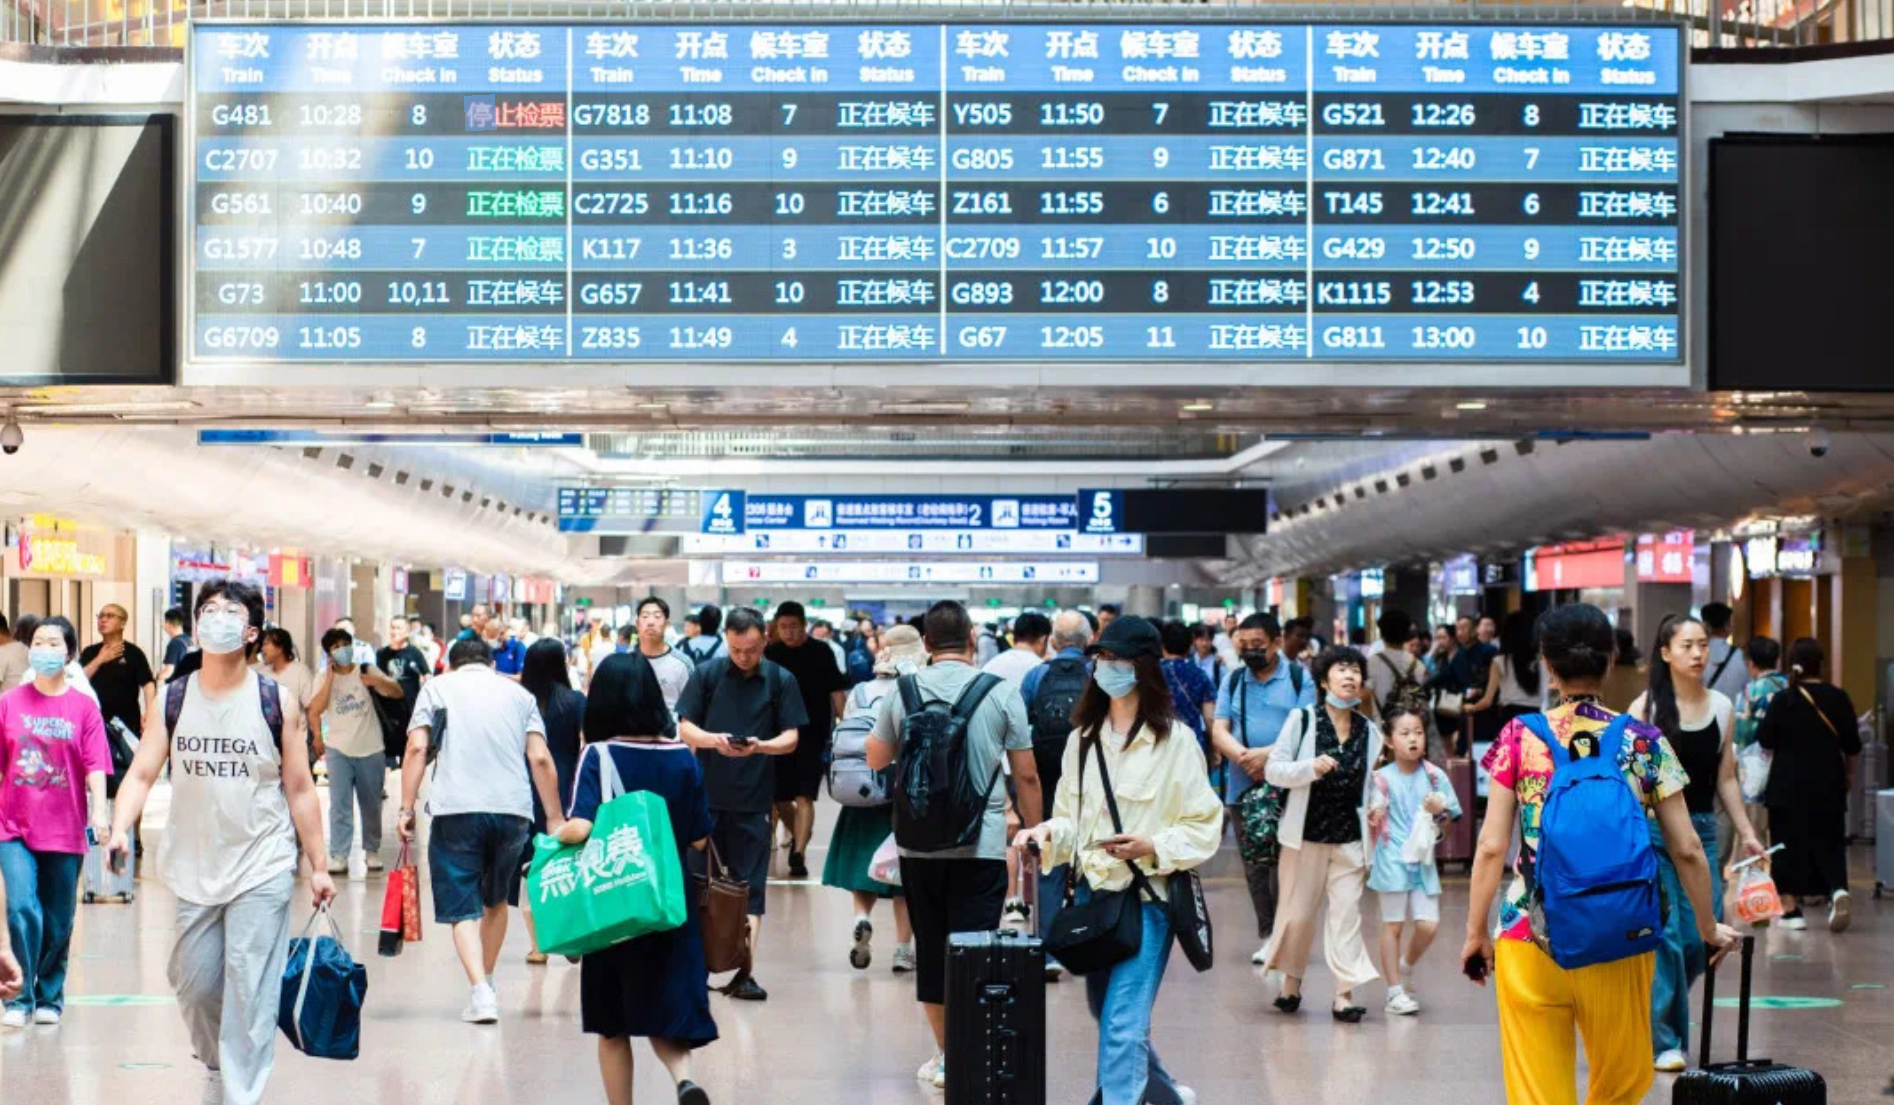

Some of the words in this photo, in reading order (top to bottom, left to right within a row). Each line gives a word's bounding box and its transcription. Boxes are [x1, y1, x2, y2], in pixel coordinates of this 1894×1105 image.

[219, 34, 269, 59] 车次
[307, 33, 359, 59] 开点
[382, 33, 458, 59] 候车室
[489, 33, 541, 59] 状态
[587, 32, 638, 59] 车次
[676, 32, 728, 59] 开点
[751, 32, 829, 59] 候车室
[858, 32, 911, 59] 状态
[957, 32, 1008, 59] 车次
[1046, 32, 1098, 59] 开点
[1121, 32, 1199, 59] 候车室
[1229, 32, 1282, 59] 状态
[1327, 32, 1379, 59] 车次
[1416, 32, 1469, 59] 开点
[1491, 32, 1568, 59] 候车室
[1598, 32, 1649, 59] 状态
[222, 68, 263, 83] Train
[382, 68, 434, 83] Check
[488, 68, 543, 83] Status
[591, 68, 633, 83] Train
[681, 68, 722, 83] Time
[751, 68, 804, 83] Check
[811, 68, 828, 83] in
[859, 68, 914, 83] Status
[962, 67, 1005, 82] Train
[1052, 67, 1094, 82] Time
[1122, 67, 1177, 82] Check
[1182, 67, 1199, 82] in
[1231, 67, 1286, 82] Status
[1333, 68, 1376, 83] Train
[1423, 68, 1465, 83] Time
[1494, 68, 1548, 83] Check
[1552, 68, 1569, 83] in
[1601, 68, 1656, 84] Status
[212, 104, 272, 127] G481
[300, 104, 361, 126] 10:28
[412, 104, 427, 126] 8
[467, 102, 564, 128] 停止检票
[574, 104, 650, 127] G7818
[670, 104, 732, 126] 11:08
[782, 104, 797, 126] 7
[838, 102, 935, 128] 正在候车
[954, 103, 1012, 126] Y505
[1041, 103, 1104, 125] 11:50
[1153, 103, 1168, 125] 7
[1209, 102, 1306, 127] 正在候车
[1323, 104, 1385, 127] G521
[1412, 104, 1476, 126] 12:26
[1524, 104, 1540, 126] 8
[1579, 103, 1676, 128] 正在候车
[206, 149, 278, 171] C2707
[300, 149, 361, 171] 10:32
[406, 149, 433, 171] 10
[467, 146, 564, 172] 正在检票
[581, 149, 642, 171] G351
[670, 149, 732, 171] 11:10
[782, 149, 797, 171] 9
[838, 146, 935, 172] 正在候车
[952, 148, 1013, 171] G805
[1041, 148, 1103, 170] 11:55
[1153, 148, 1169, 170] 9
[1209, 146, 1306, 172] 正在候车
[1323, 149, 1385, 171] G871
[1412, 149, 1475, 171] 12:40
[1524, 149, 1539, 171] 7
[1579, 147, 1676, 173] 正在候车
[212, 193, 271, 216] G561
[301, 193, 361, 215] 10:40
[412, 193, 426, 215] 9
[467, 191, 564, 217] 正在检票
[575, 193, 649, 216] C2725
[670, 193, 732, 215] 11:16
[776, 193, 804, 215] 10
[838, 191, 935, 217] 正在候车
[953, 192, 1012, 215] Z161
[1041, 192, 1103, 214] 11:55
[1153, 192, 1169, 214] 6
[1209, 191, 1306, 217] 正在候车
[1324, 193, 1383, 216] T145
[1412, 193, 1474, 215] 12:41
[1524, 193, 1540, 215] 6
[1579, 192, 1676, 218] 正在候车
[204, 238, 278, 261] G1577
[301, 238, 361, 260] 10:48
[412, 238, 426, 260] 7
[467, 236, 564, 262] 正在检票
[582, 238, 641, 261] K117
[670, 238, 732, 260] 11:36
[782, 238, 797, 260] 3
[838, 236, 935, 262] 正在候车
[946, 238, 1020, 260] C2709
[1041, 238, 1103, 259] 11:57
[1147, 238, 1176, 259] 10
[1209, 236, 1306, 262] 正在候车
[1323, 238, 1385, 261] G429
[1412, 238, 1475, 260] 12:50
[1524, 238, 1539, 260] 9
[1579, 237, 1676, 263] 正在候车
[219, 282, 264, 305] G73
[300, 282, 361, 304] 11:00
[388, 282, 449, 307] 10,11
[467, 281, 564, 306] 正在候车
[581, 282, 642, 305] G657
[670, 282, 731, 304] 11:41
[776, 282, 804, 304] 10
[838, 281, 935, 306] 正在候车
[952, 282, 1013, 304] G893
[1041, 282, 1103, 304] 12:00
[1153, 282, 1169, 304] 8
[1209, 281, 1306, 306] 正在候车
[1319, 282, 1391, 305] K1115
[1412, 282, 1474, 304] 12:53
[1522, 282, 1540, 304] 4
[1579, 282, 1676, 307] 正在候车
[204, 327, 279, 349] G6709
[300, 327, 361, 349] 11:05
[412, 327, 426, 349] 8
[467, 326, 564, 351] 正在候车
[582, 327, 641, 349] Z835
[670, 327, 732, 349] 11:49
[781, 327, 798, 349] 4
[838, 326, 935, 351] 正在候车
[959, 326, 1006, 349] G67
[1041, 326, 1103, 348] 12:05
[1147, 326, 1175, 348] 11
[1209, 325, 1306, 350] 正在候车
[1323, 327, 1385, 349] G811
[1412, 327, 1474, 349] 13:00
[1518, 327, 1547, 349] 10
[1579, 327, 1676, 352] 正在候车
[713, 493, 732, 519] 4
[968, 504, 982, 526] 2
[1093, 491, 1112, 518] 5
[177, 736, 258, 755] BOTTEGA
[183, 760, 249, 777] VENETA
